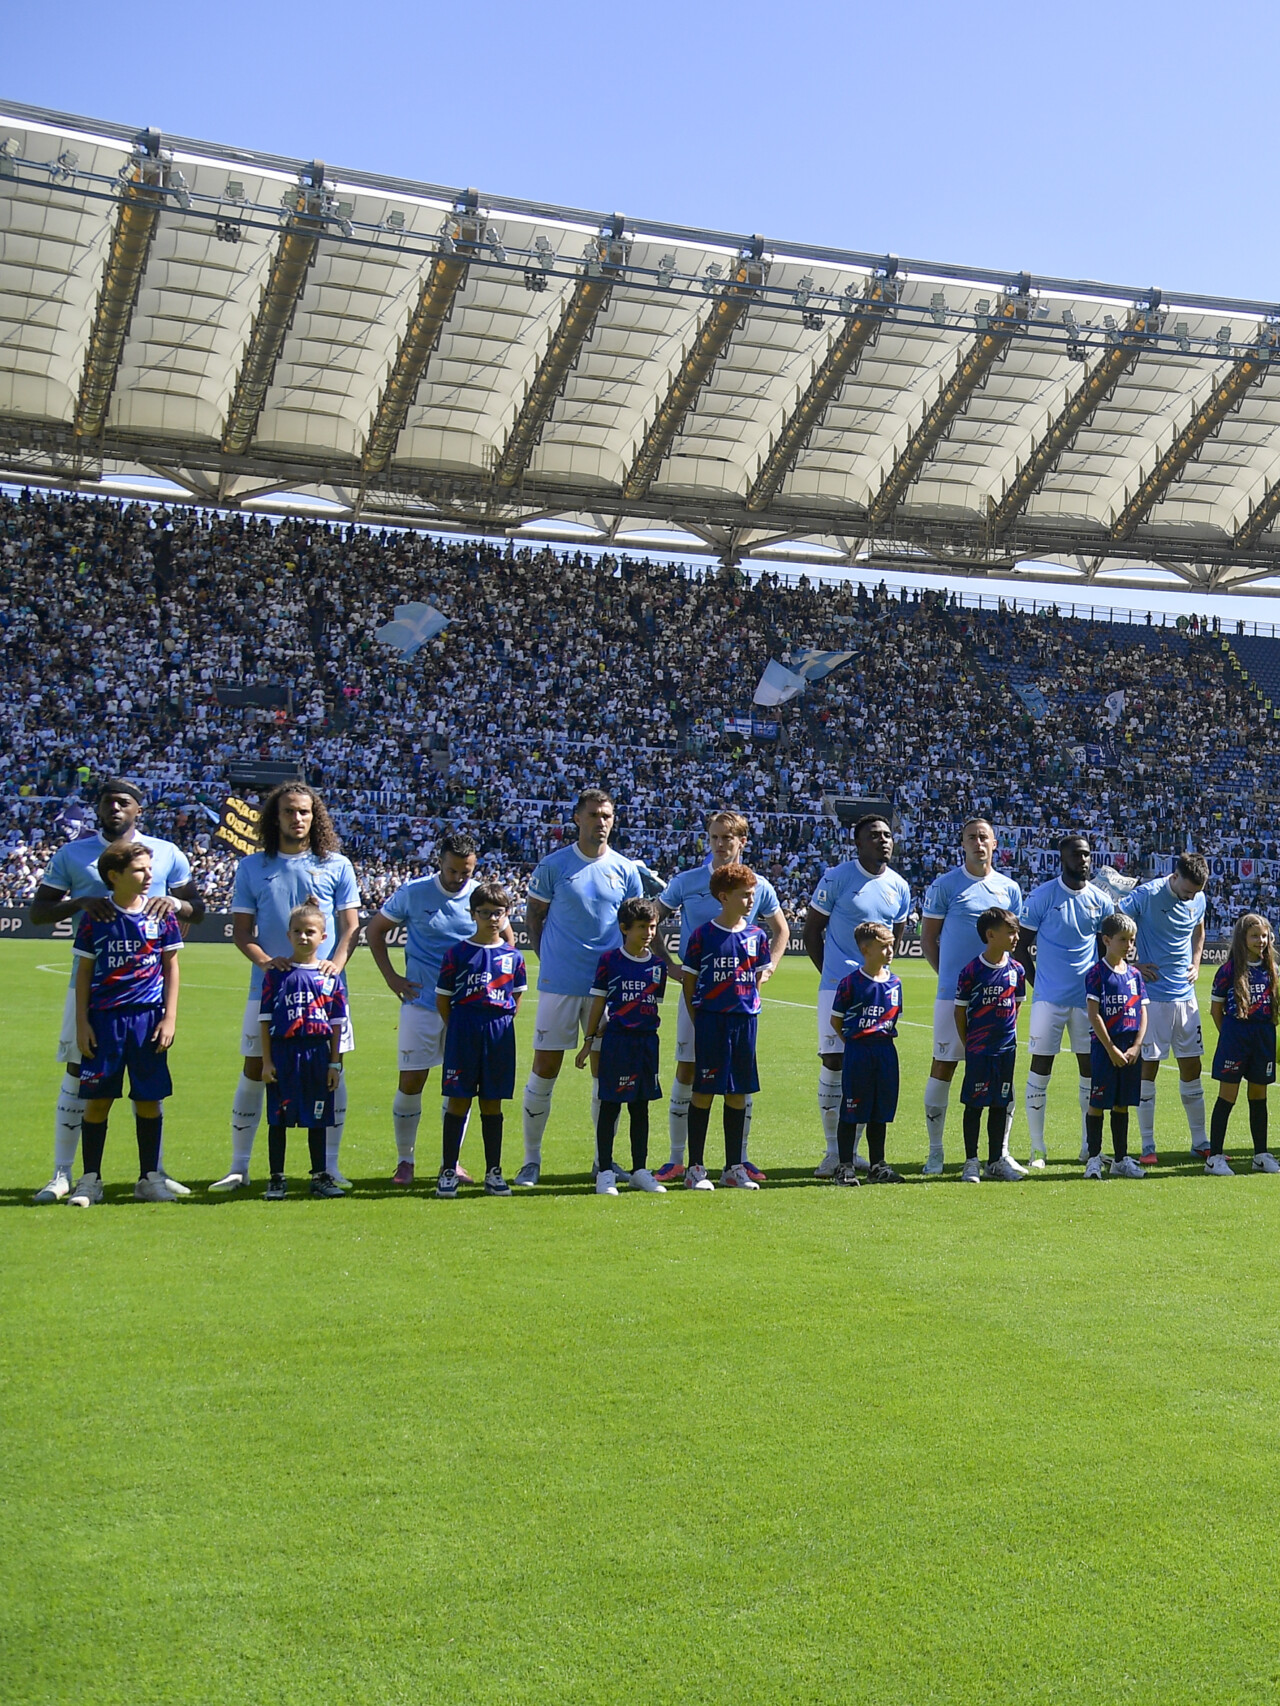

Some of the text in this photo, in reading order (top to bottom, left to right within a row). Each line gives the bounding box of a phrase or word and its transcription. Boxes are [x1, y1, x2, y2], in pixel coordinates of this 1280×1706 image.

[107, 940, 142, 953] KEEP
[713, 957, 741, 969] KEEP
[466, 971, 493, 985] KEEP
[621, 980, 647, 991] KEEP
[734, 985, 753, 996] OUT
[982, 986, 1004, 996] KEEP
[284, 991, 315, 1007] KEEP
[1104, 994, 1129, 1005] KEEP
[862, 1005, 885, 1017] KEEP
[858, 1017, 894, 1031] RACSM
